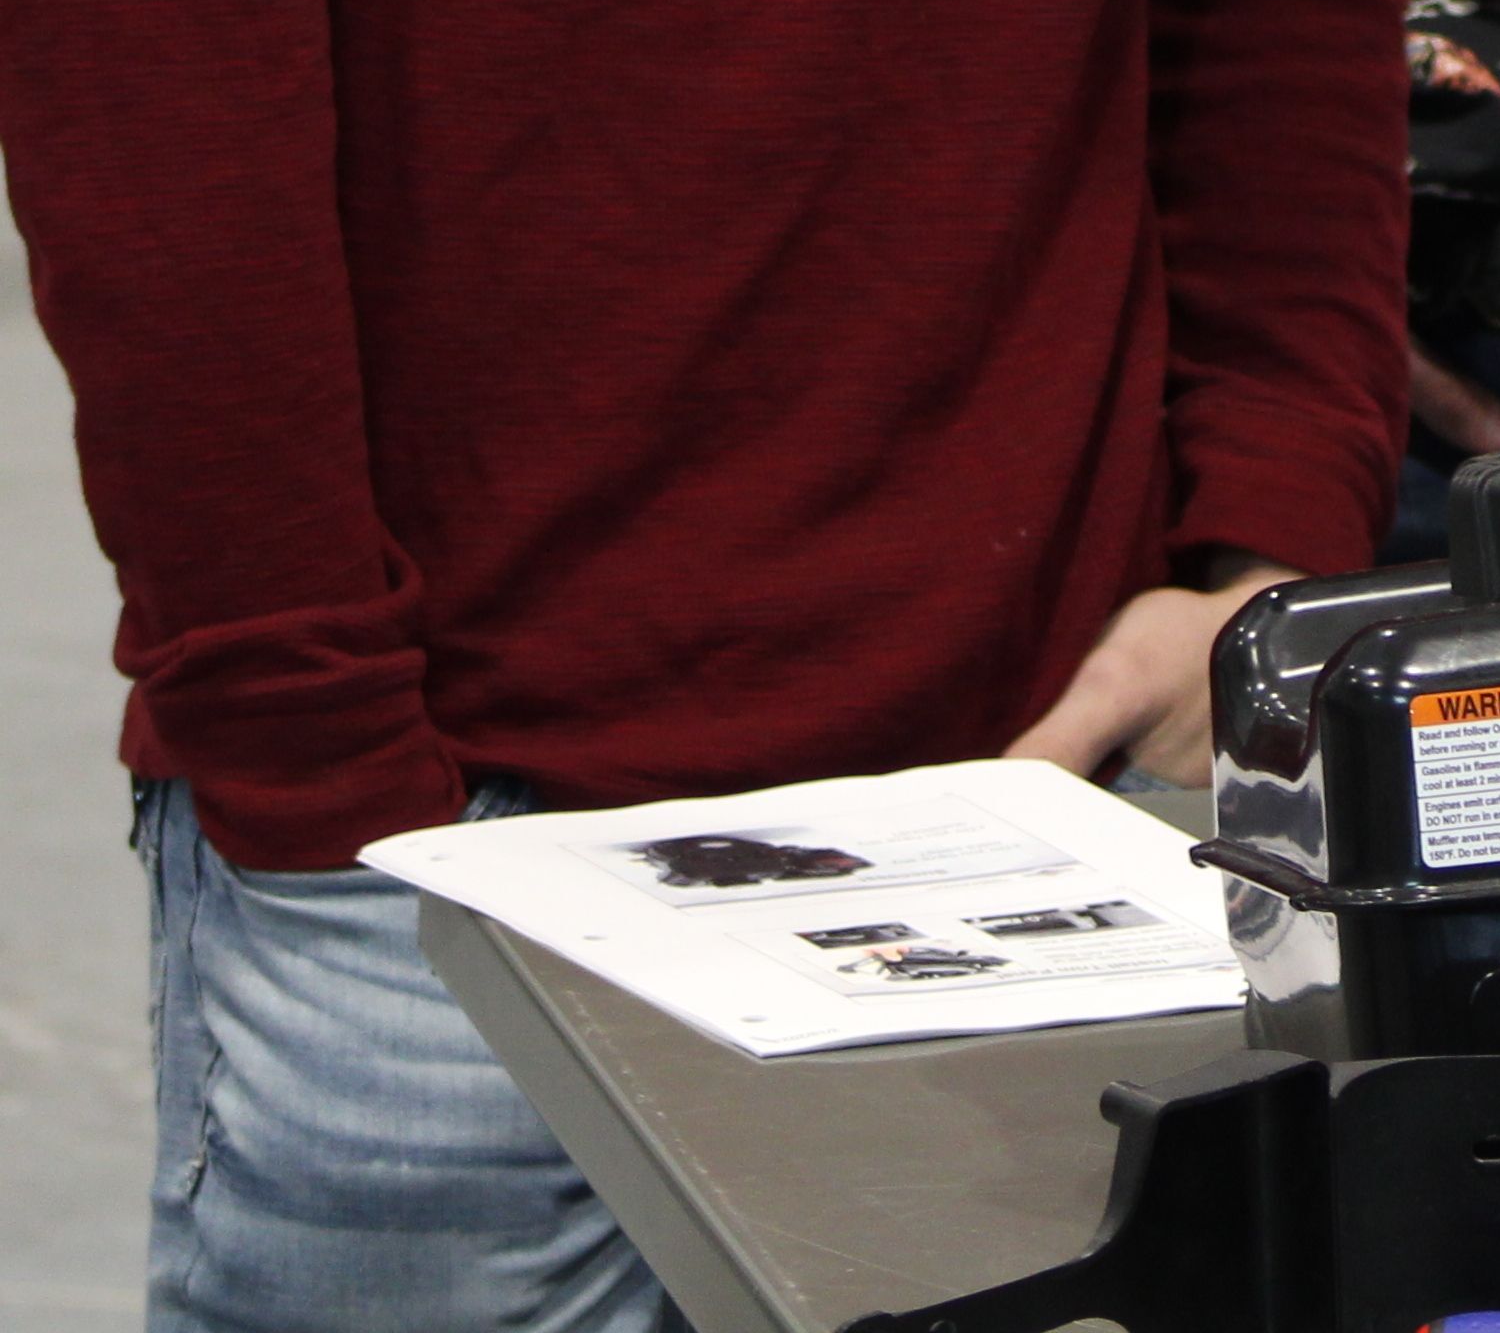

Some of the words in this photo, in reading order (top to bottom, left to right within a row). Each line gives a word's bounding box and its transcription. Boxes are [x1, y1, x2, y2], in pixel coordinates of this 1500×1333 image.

[1419, 729, 1442, 741] Read
[1445, 727, 1461, 738] and
[1463, 726, 1490, 736] follow
[1421, 745, 1449, 755] before
[1452, 741, 1486, 752] running
[1489, 740, 1498, 748] or
[1423, 764, 1461, 776] Gasoline
[1464, 763, 1471, 771] is
[1424, 780, 1443, 790] cool
[1446, 778, 1454, 788] at
[1457, 776, 1478, 787] least
[1480, 775, 1485, 784] 2
[1426, 801, 1461, 813] Engines
[1464, 797, 1483, 807] emit
[1427, 816, 1440, 826] DO
[1444, 814, 1461, 824] NOT
[1465, 814, 1480, 822] run
[1483, 812, 1491, 820] in
[1429, 835, 1459, 846] Muffler
[1462, 834, 1481, 842] area
[1459, 848, 1473, 857] Do
[1474, 846, 1488, 856] not
